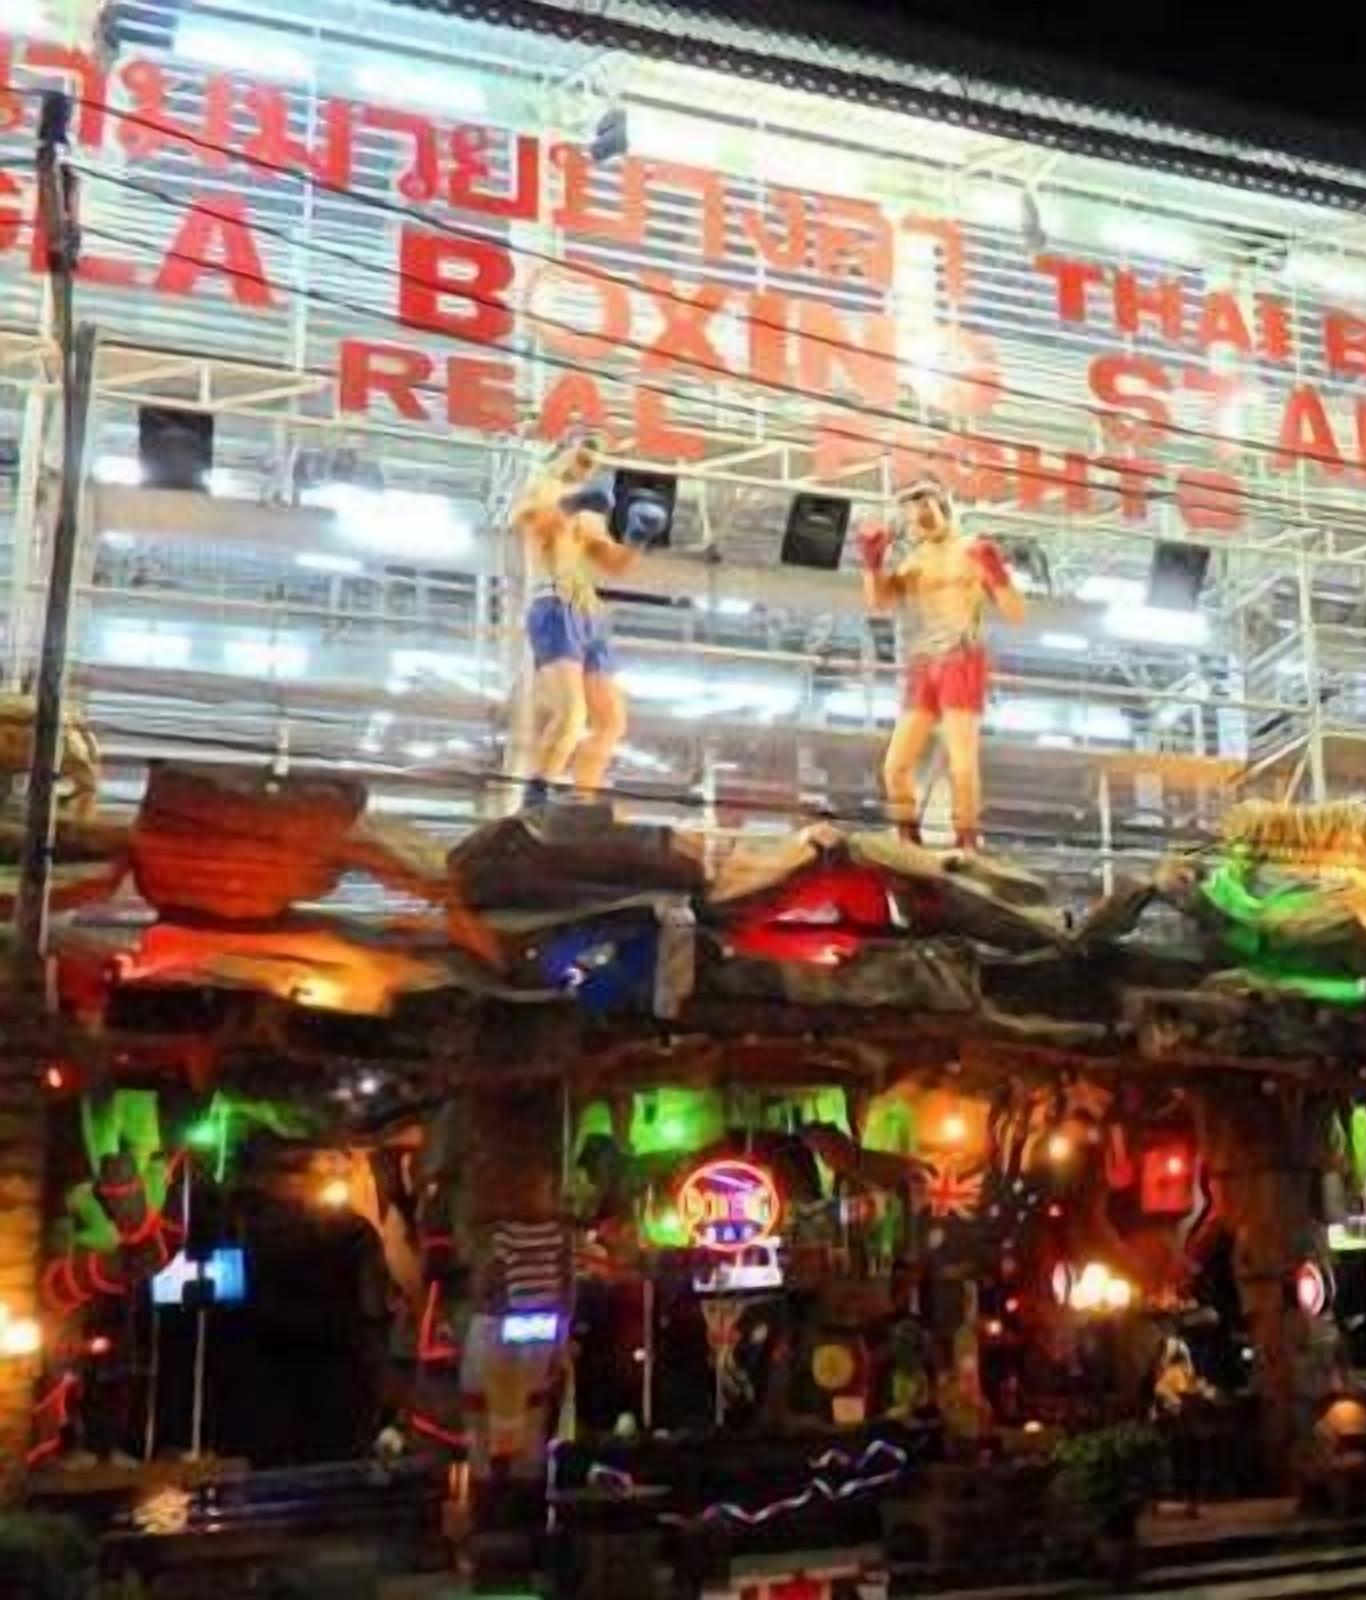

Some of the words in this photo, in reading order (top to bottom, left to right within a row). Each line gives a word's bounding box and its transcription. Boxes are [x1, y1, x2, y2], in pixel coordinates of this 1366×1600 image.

[0, 168, 275, 308] LA
[1034, 254, 1292, 362] THAI
[340, 340, 706, 458] REAL
